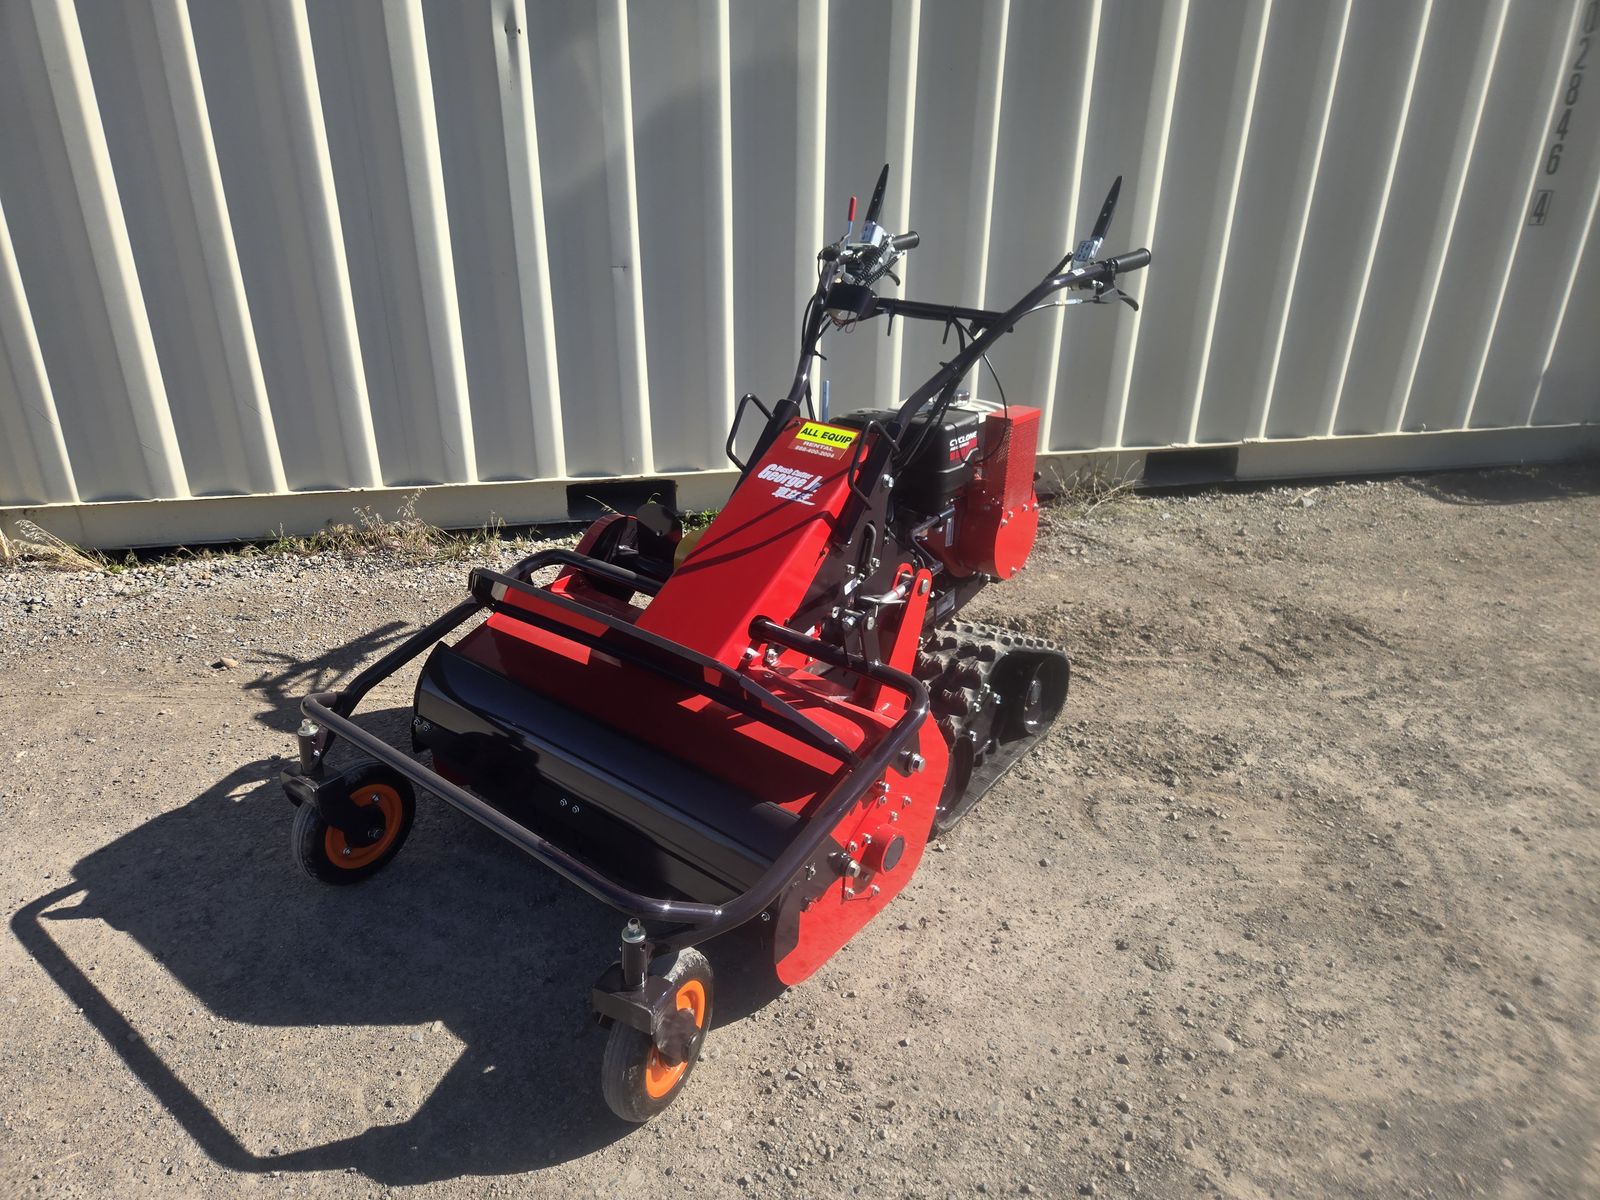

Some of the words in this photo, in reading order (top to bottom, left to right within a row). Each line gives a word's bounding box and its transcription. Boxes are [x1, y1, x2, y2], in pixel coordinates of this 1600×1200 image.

[1533, 192, 1549, 224] 4
[800, 427, 819, 438] ALL
[820, 431, 853, 444] EQUIP
[949, 430, 978, 447] CYCLONE
[802, 440, 834, 452] RENTAL
[757, 463, 808, 488] George
